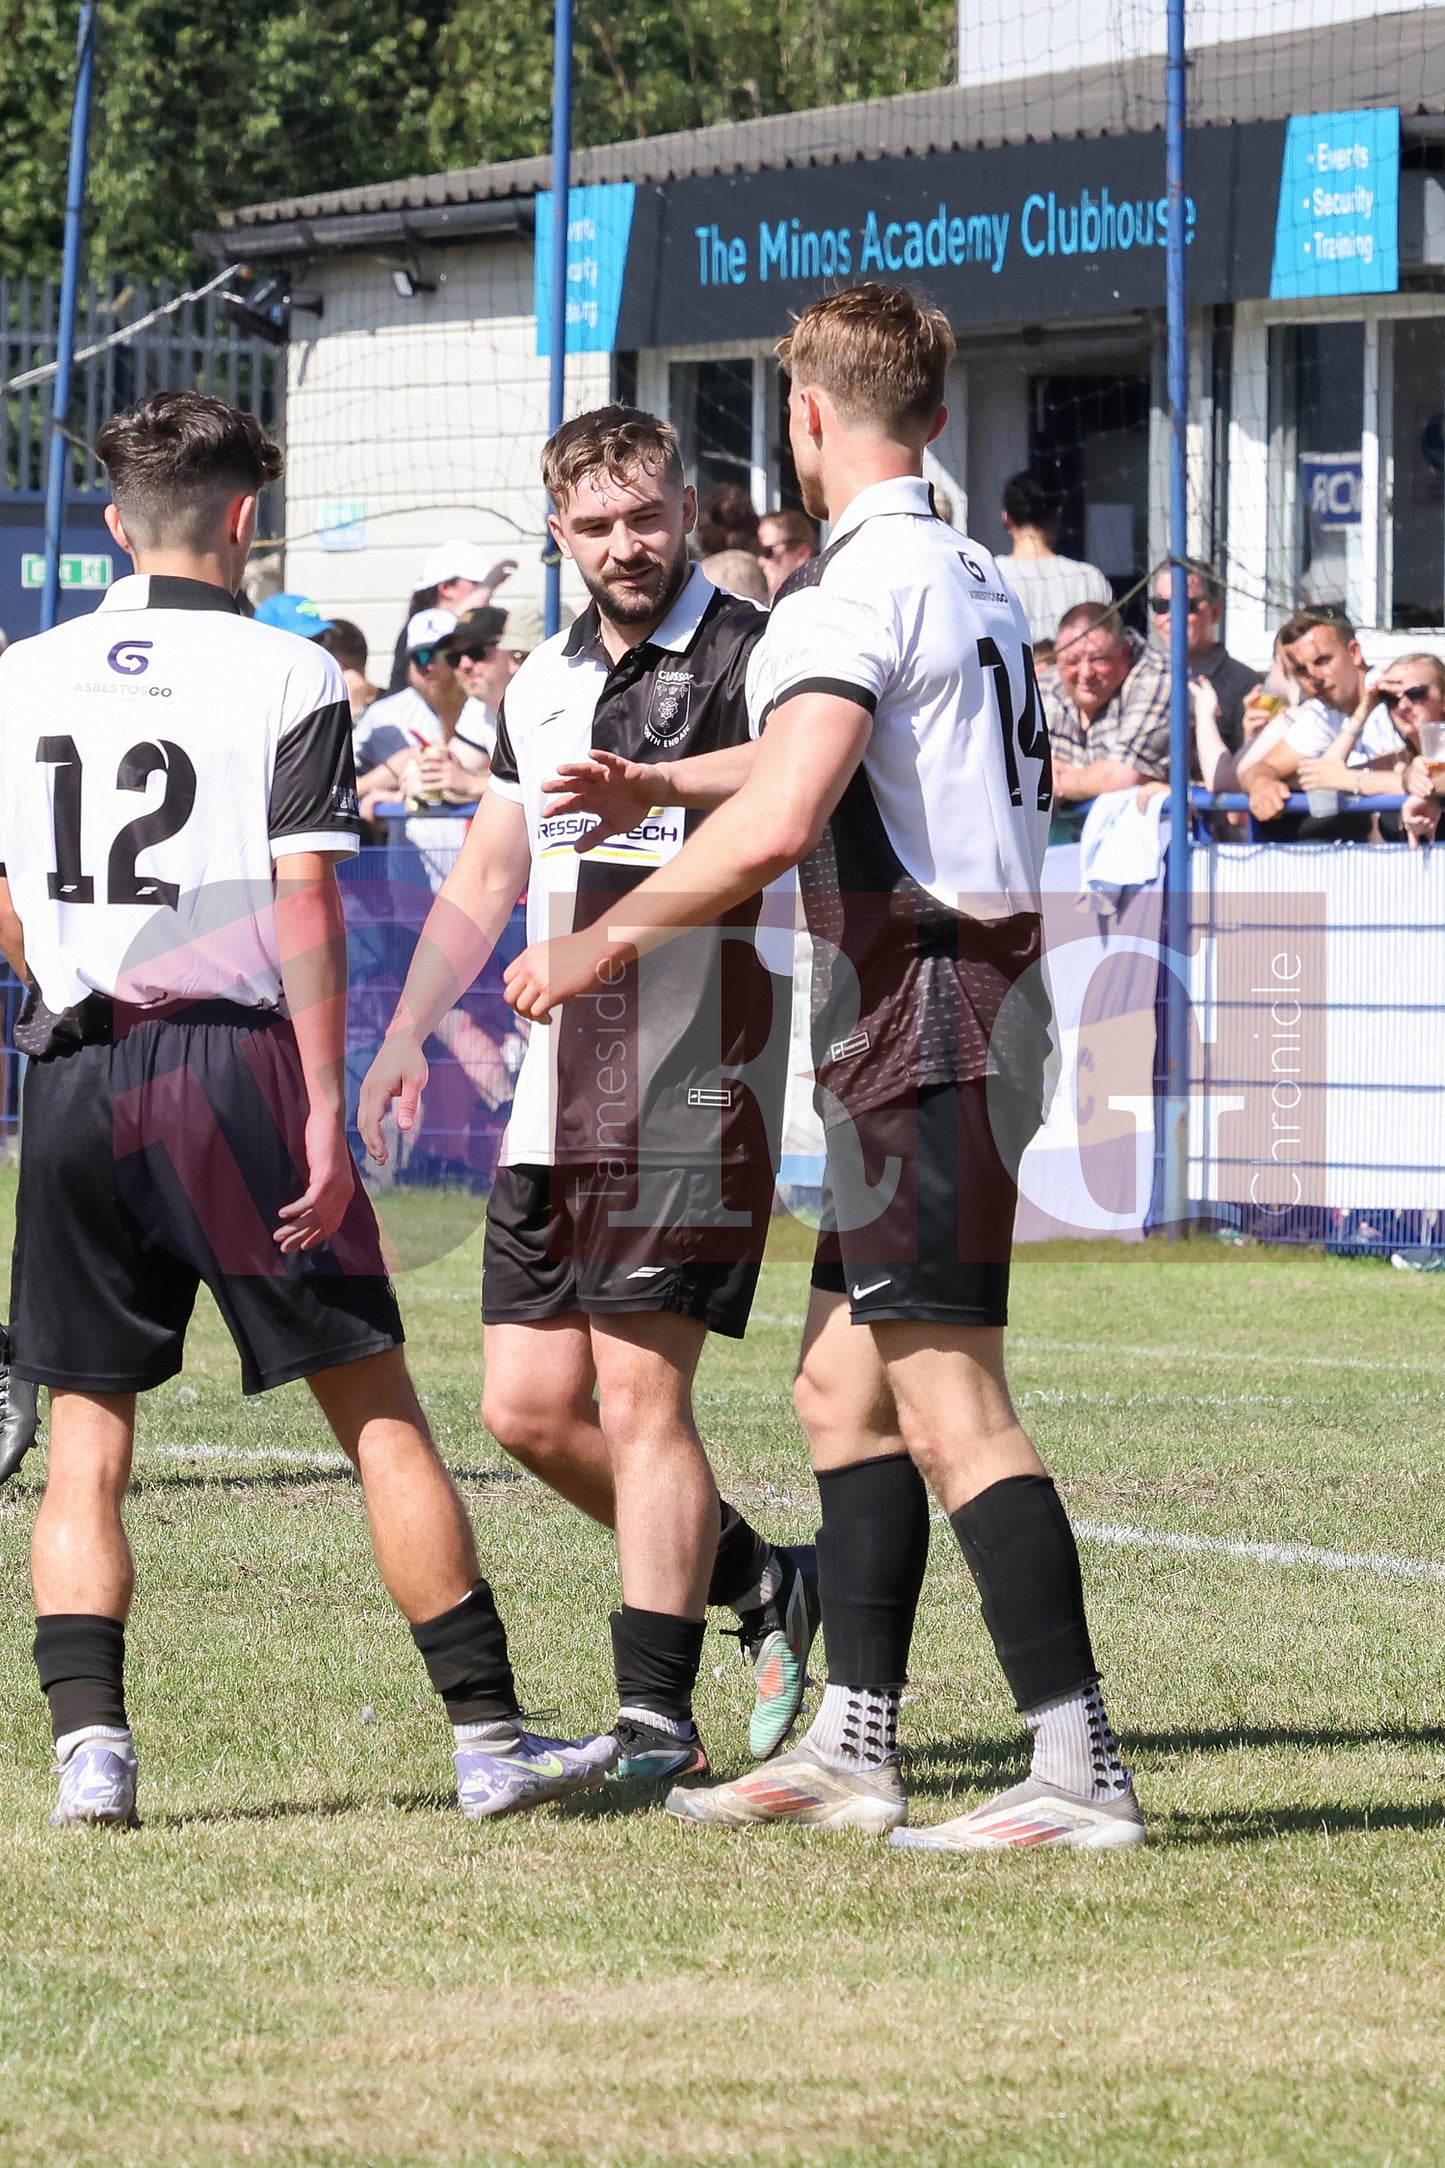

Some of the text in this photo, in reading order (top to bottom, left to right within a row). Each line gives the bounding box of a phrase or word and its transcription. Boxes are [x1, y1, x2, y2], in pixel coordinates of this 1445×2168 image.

[1317, 142, 1369, 172] Events
[1312, 185, 1374, 219] Security
[694, 186, 1197, 286] The Minos Academy Clubhouse
[1313, 230, 1373, 264] Training
[74, 682, 172, 698] ASBESTOSGO
[977, 637, 1053, 812] 14
[664, 737, 680, 748] END
[36, 735, 197, 911] 12
[625, 826, 678, 842] ECH
